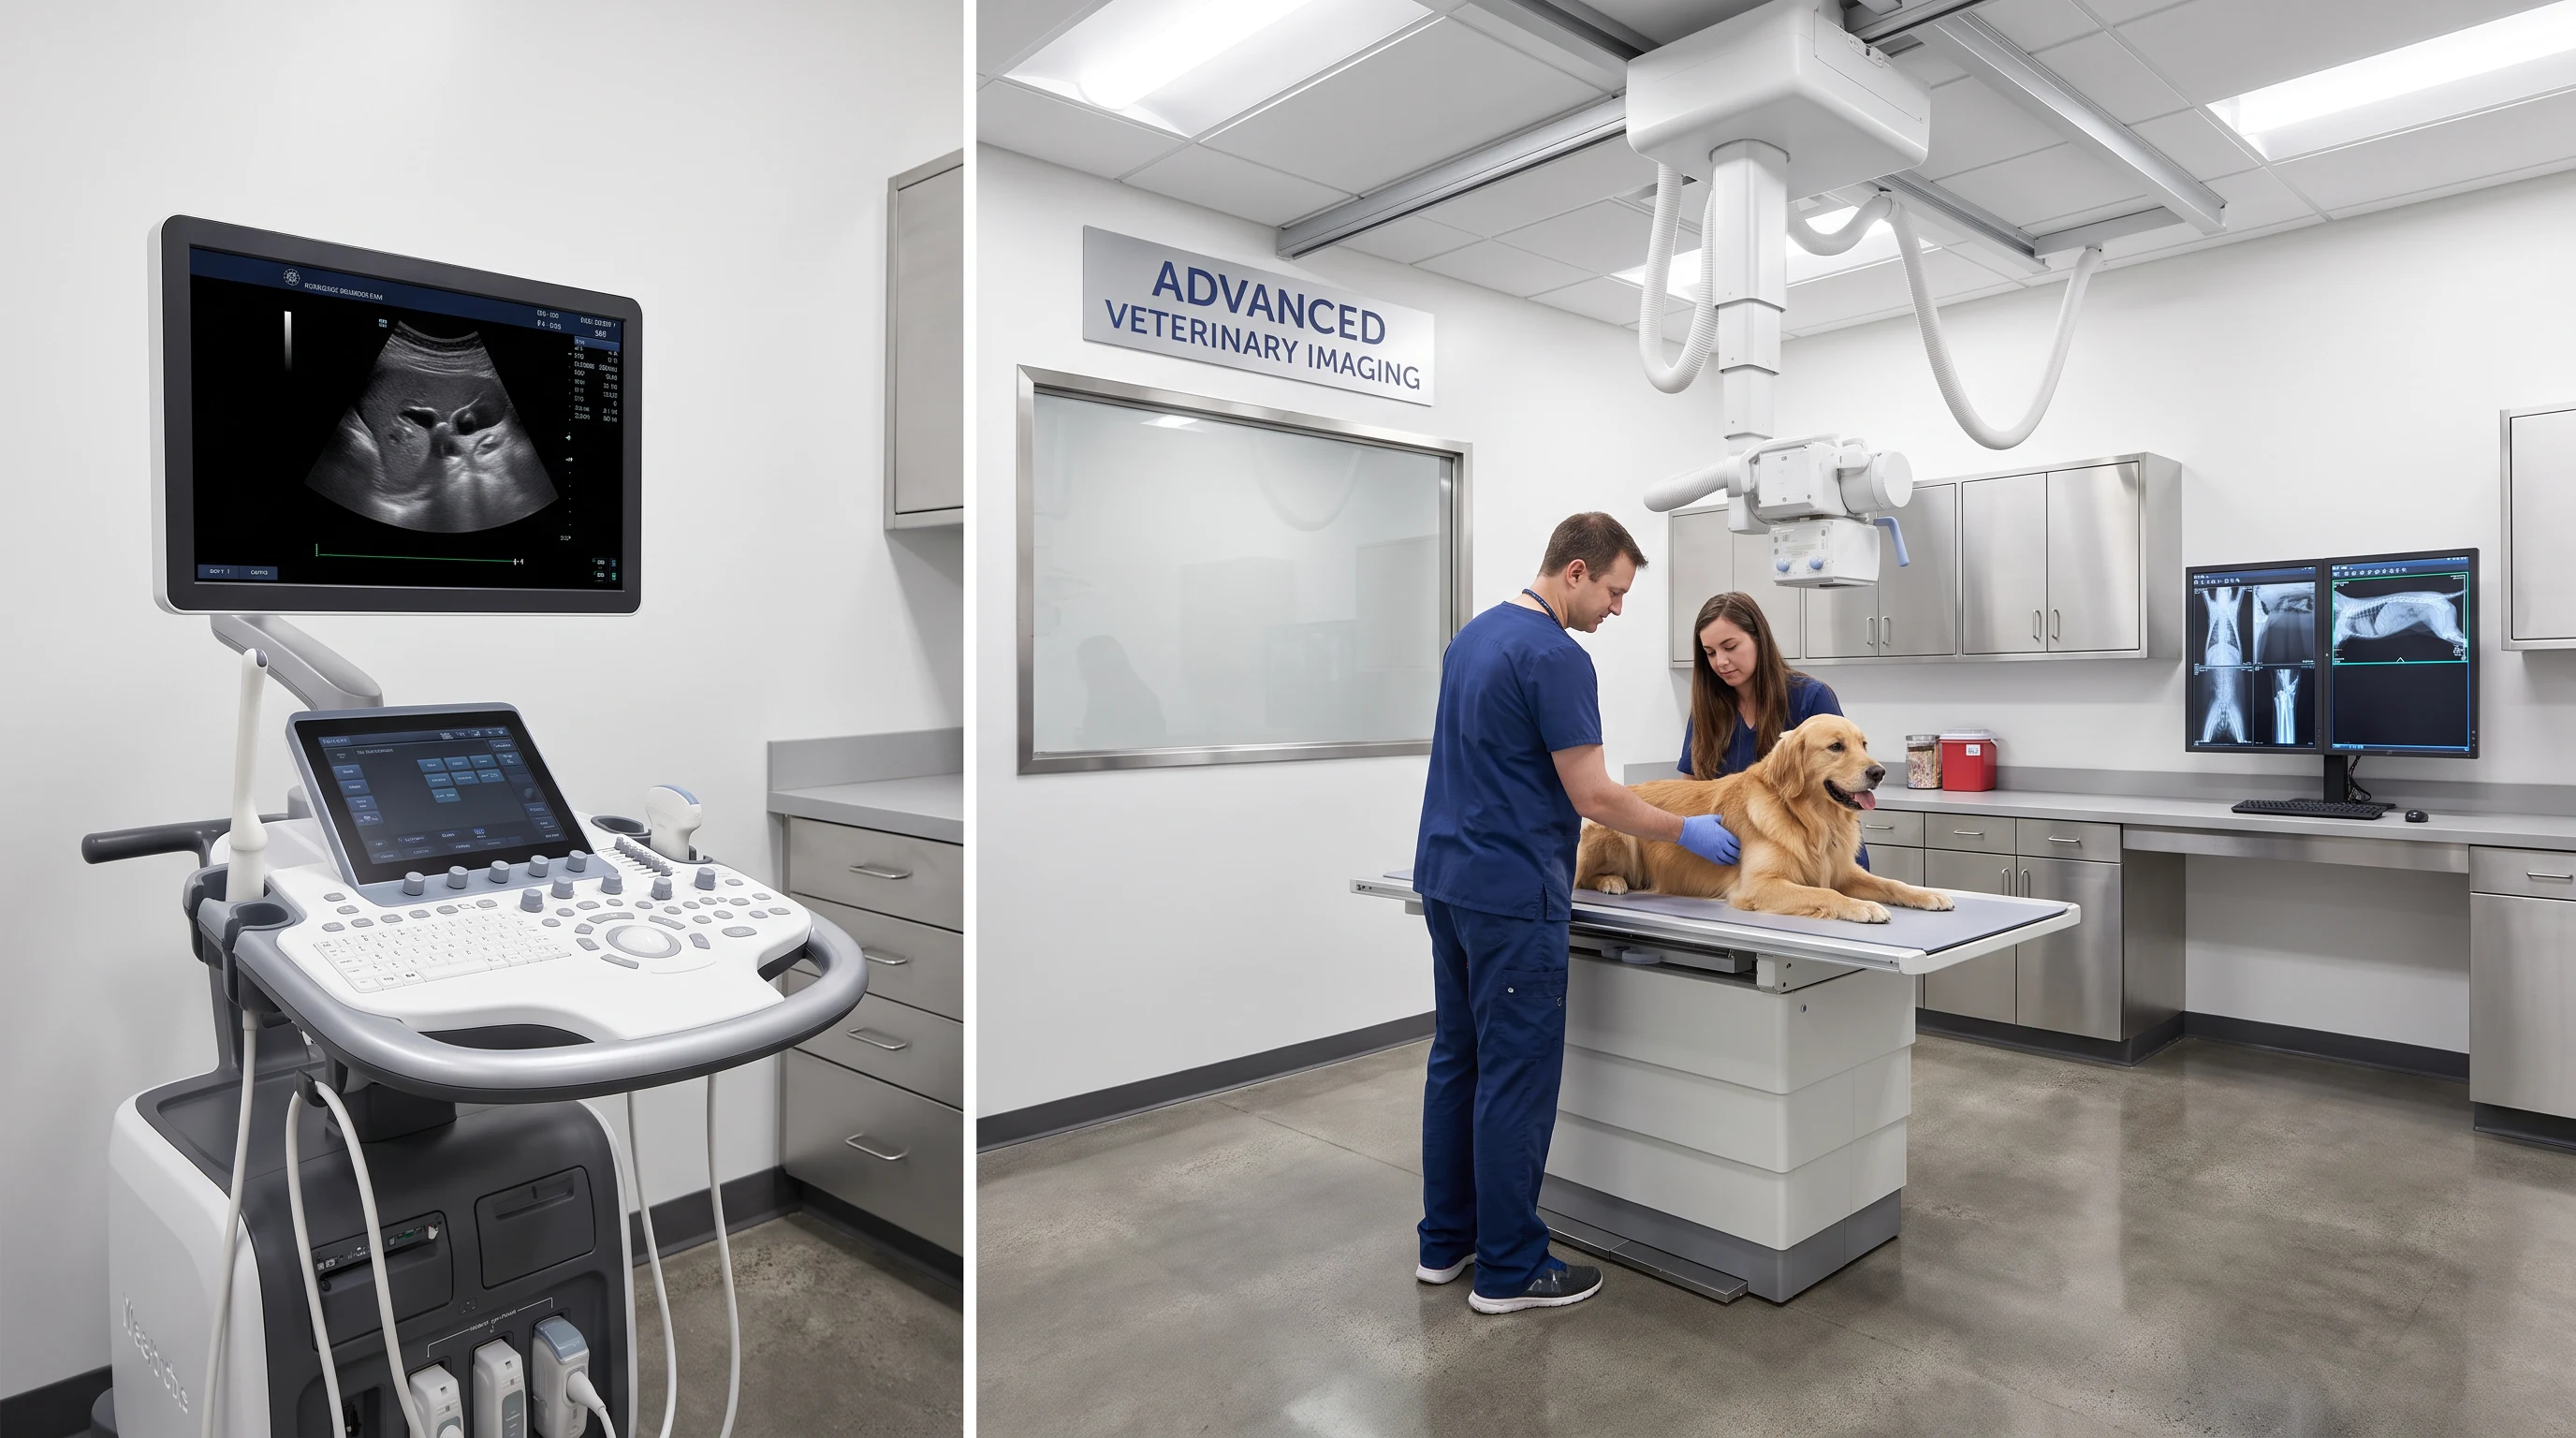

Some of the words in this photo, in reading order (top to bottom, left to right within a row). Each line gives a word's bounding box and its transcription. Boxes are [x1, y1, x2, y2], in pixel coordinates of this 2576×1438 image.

[1105, 300, 1298, 364] VETERINARY
[1308, 344, 1420, 390] IMAGING
[1151, 260, 1385, 345] ADVANCED
